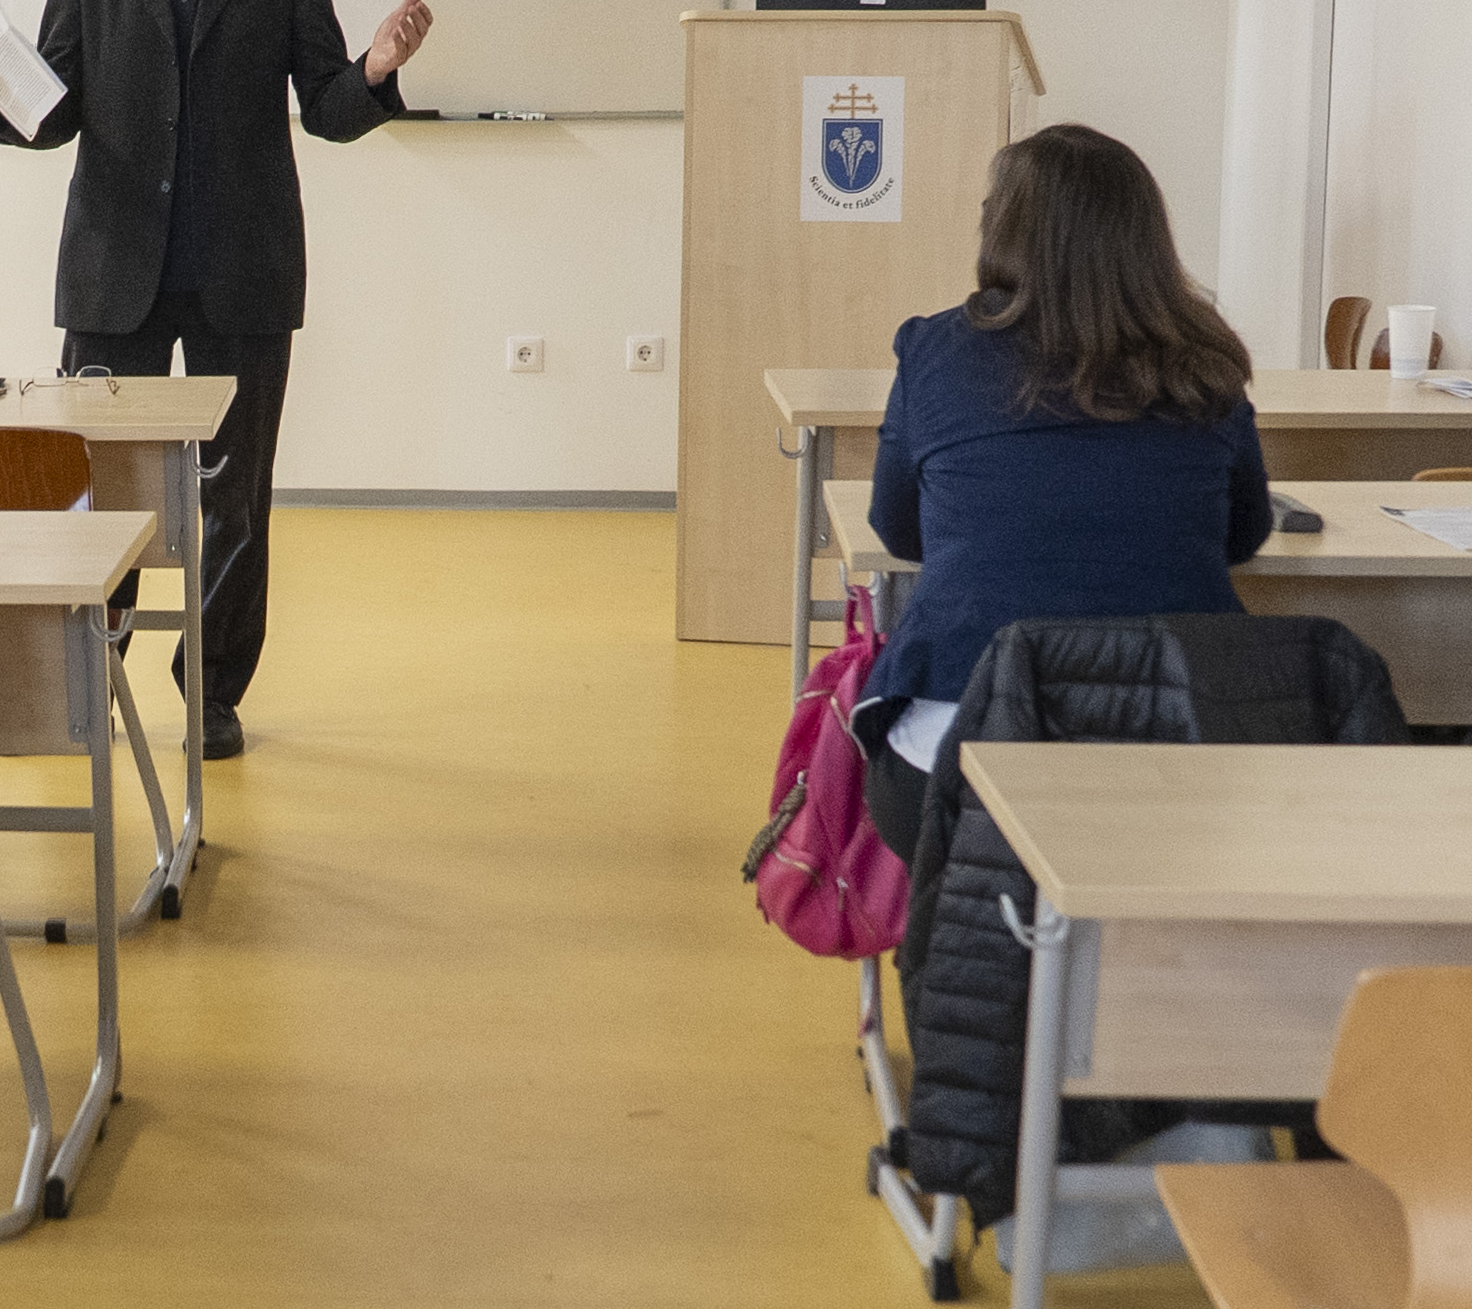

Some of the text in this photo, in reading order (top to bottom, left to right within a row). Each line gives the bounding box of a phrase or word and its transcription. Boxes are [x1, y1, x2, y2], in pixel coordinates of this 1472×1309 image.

[809, 175, 895, 210] Scientia et fidelitate
